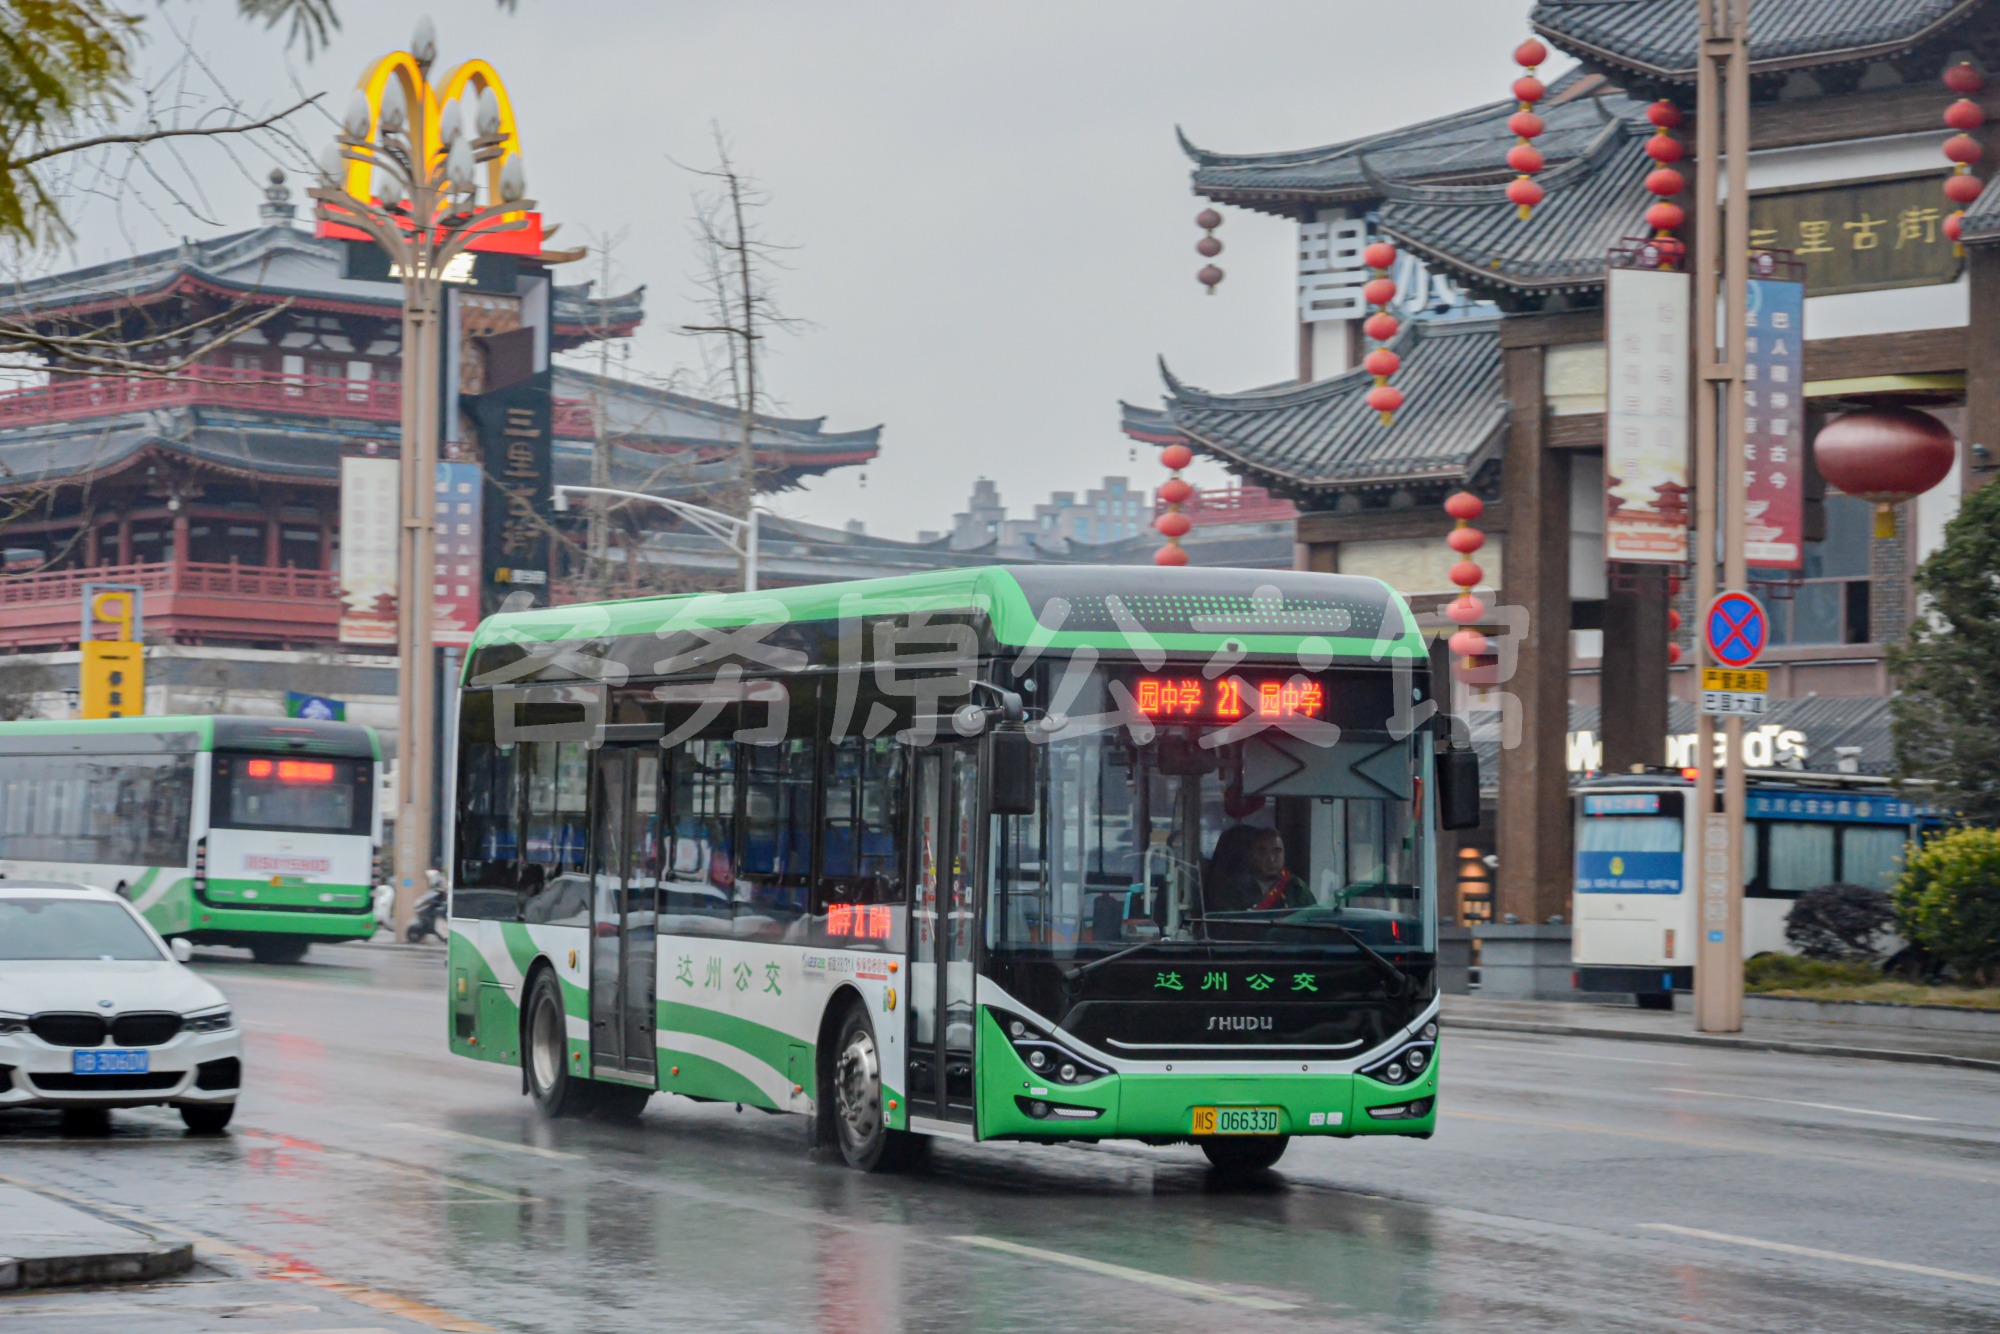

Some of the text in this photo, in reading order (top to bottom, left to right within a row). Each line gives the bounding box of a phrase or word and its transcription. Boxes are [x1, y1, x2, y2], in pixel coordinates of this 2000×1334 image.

[1747, 205, 1941, 256] 三里古街
[502, 407, 541, 558] 三里古街
[1139, 680, 1322, 716] 园中学 21 园中学
[1706, 694, 1763, 713] 巴国大道
[675, 954, 782, 996] 达州公交
[1154, 971, 1319, 992] 达州公交
[1207, 1016, 1273, 1030] SHUDU
[1195, 1111, 1277, 1130] 川S 06633D
